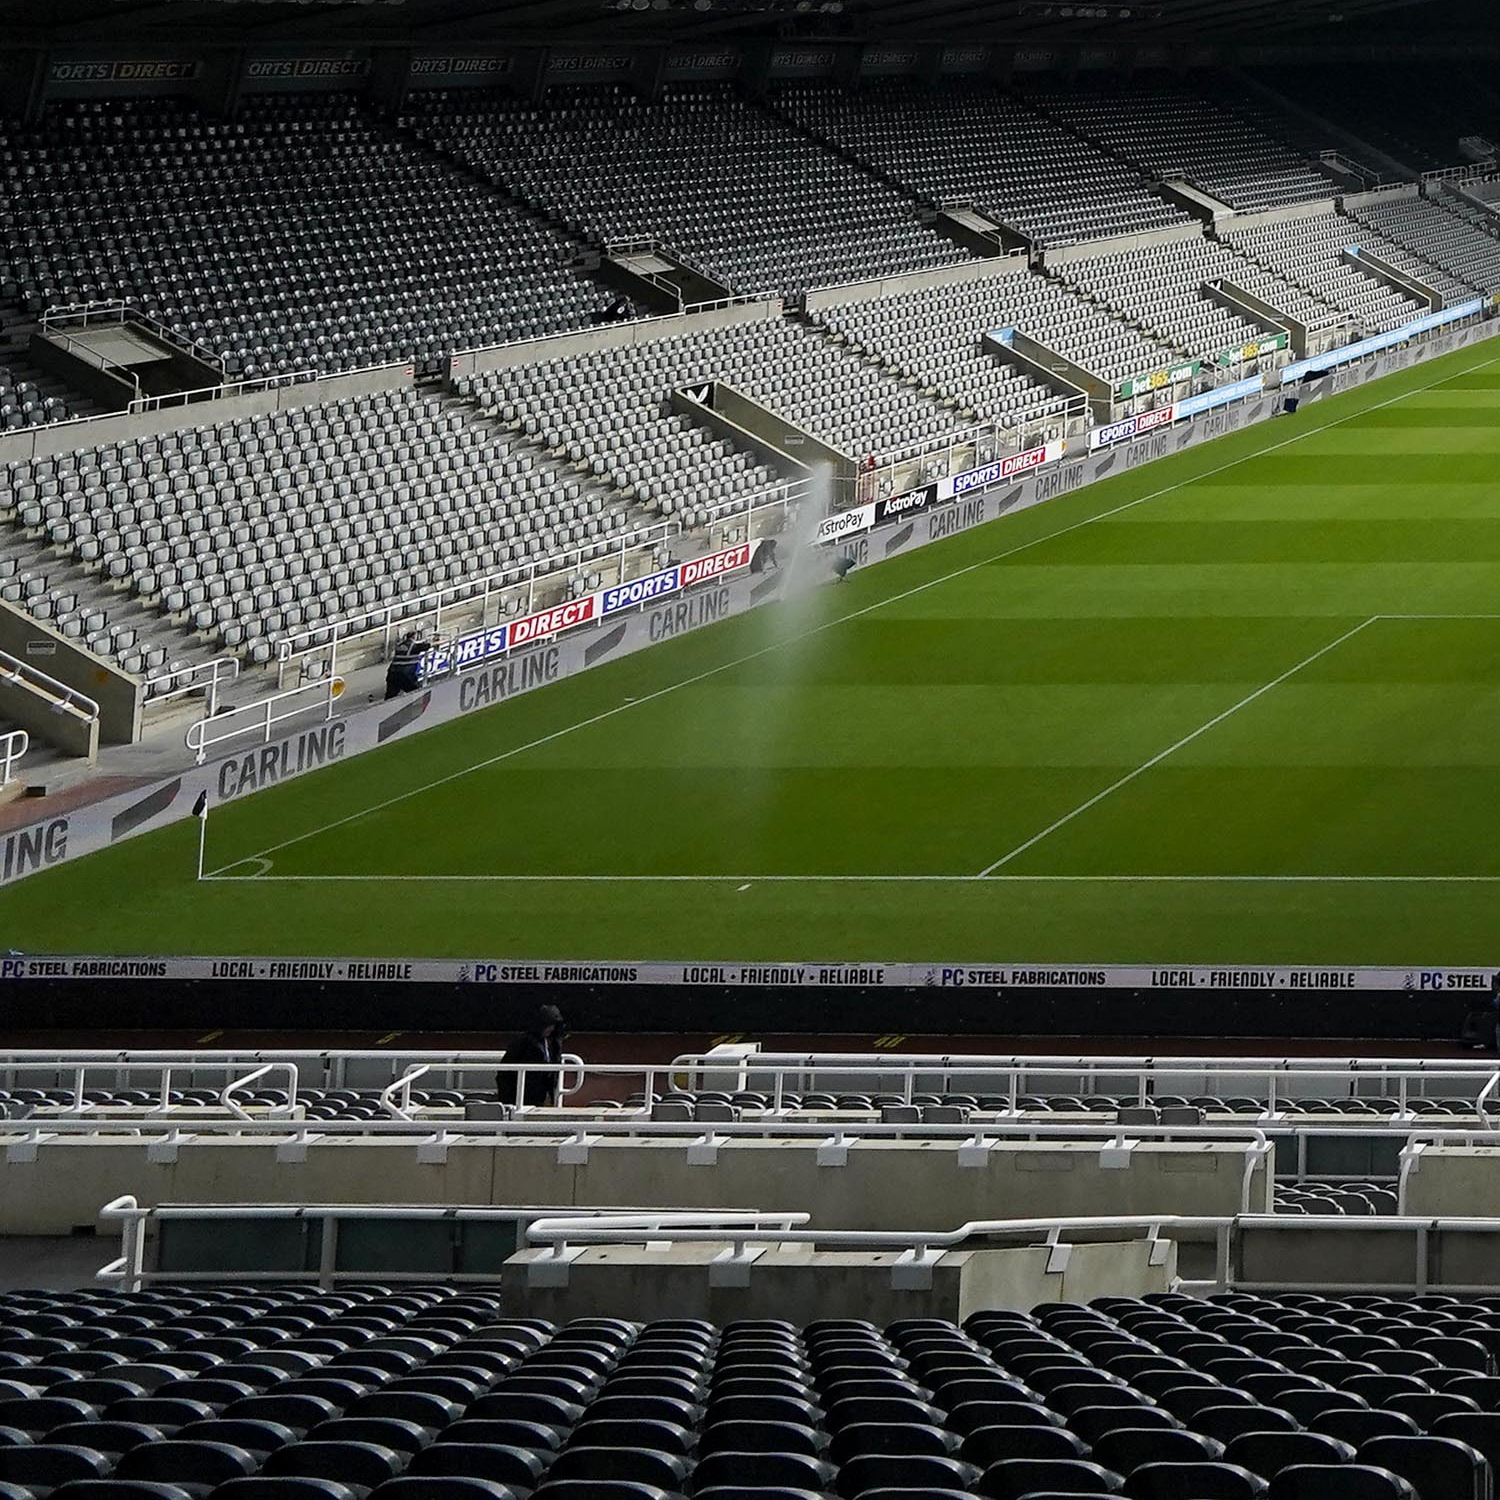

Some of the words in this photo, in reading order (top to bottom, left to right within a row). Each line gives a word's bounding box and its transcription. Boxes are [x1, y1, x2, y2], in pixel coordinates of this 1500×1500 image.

[52, 62, 109, 80] ORTS
[247, 61, 294, 77] ORTS
[409, 59, 446, 74] ORTS
[1132, 366, 1193, 392] bet365.com
[1099, 421, 1135, 444] SPORTS
[1138, 407, 1172, 431] DIRECT
[1125, 435, 1166, 468] CARLING
[954, 463, 1000, 492] SPORTS
[1003, 449, 1045, 476] DIRECT
[1035, 465, 1082, 500] CARLING
[882, 488, 928, 516] AstroPay
[817, 511, 863, 538] AstroPay
[928, 501, 983, 539] CARLING
[607, 568, 676, 610] SPORTS
[684, 546, 748, 586] DIRECT
[513, 598, 590, 645] DIRECT
[650, 587, 730, 642] CARLING
[459, 647, 559, 712] CARLING
[217, 722, 347, 800] CARLING
[1, 961, 24, 978] PC
[29, 963, 68, 977] STEEL
[72, 962, 166, 977] FABRICATIONS
[212, 962, 255, 978] LOCAL
[269, 963, 333, 979] FRIENDLY
[347, 963, 411, 980] RELIABLE
[475, 965, 497, 981] PC
[501, 967, 540, 981] STEEL
[544, 967, 637, 982] FABRICATIONS
[683, 968, 725, 983] LOCAL
[741, 968, 802, 984] FRIENDLY
[819, 969, 884, 985] RELIABLE
[942, 969, 963, 986] PC
[968, 971, 1007, 985] STEEL
[1012, 971, 1106, 986] FABRICATIONS
[1152, 971, 1195, 987] LOCAL
[1210, 972, 1275, 987] FRIENDLY
[1290, 972, 1354, 988] RELIABLE
[1420, 973, 1441, 988] PC
[1447, 974, 1487, 988] STEEL
